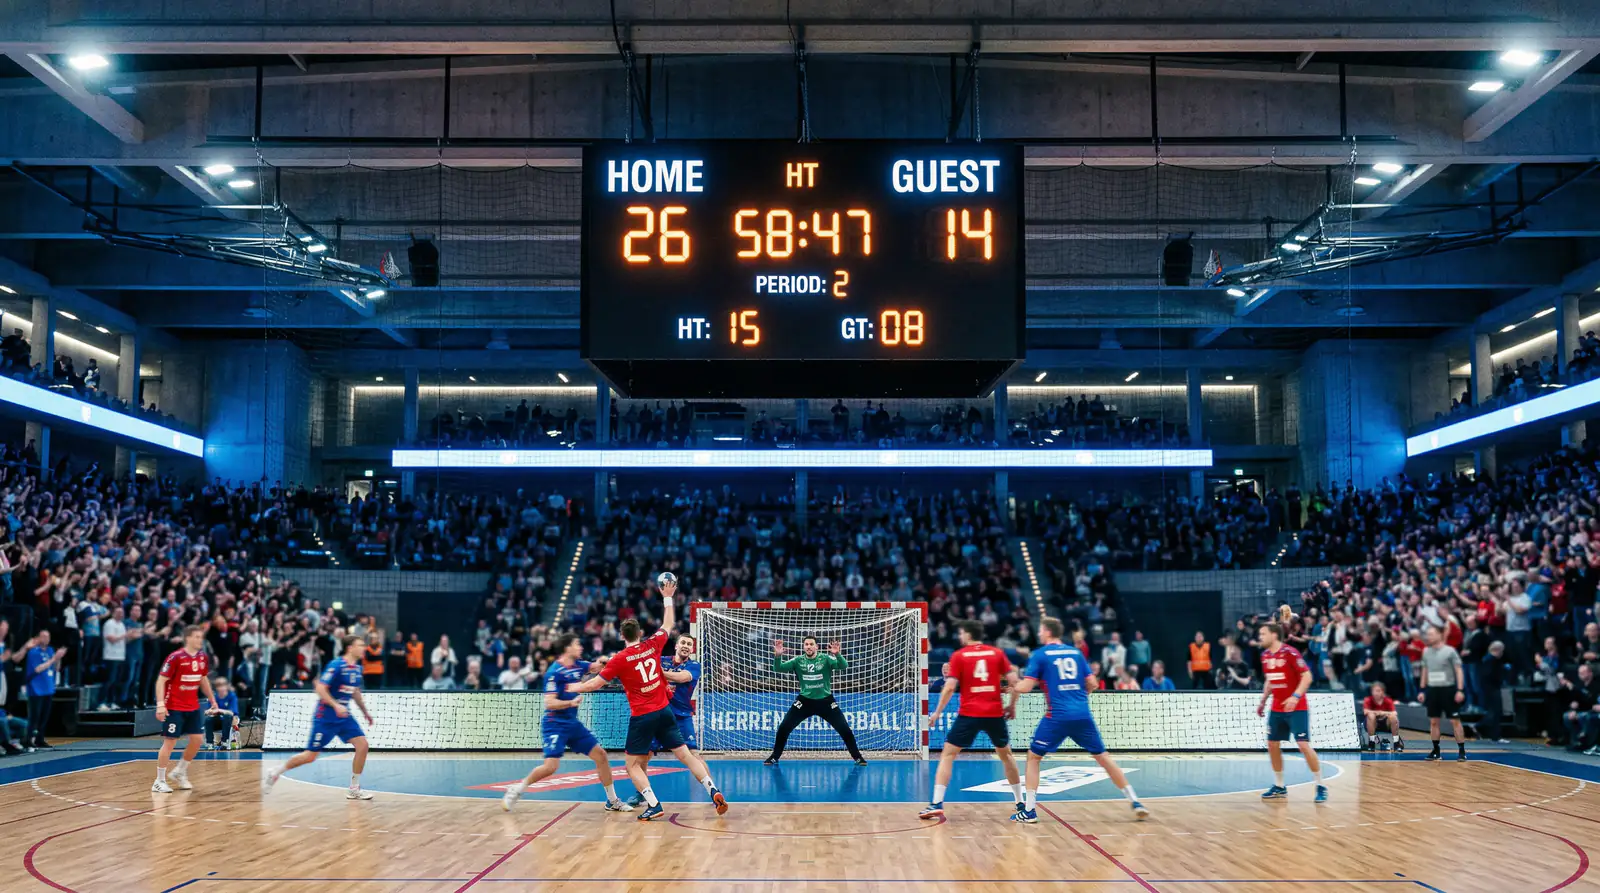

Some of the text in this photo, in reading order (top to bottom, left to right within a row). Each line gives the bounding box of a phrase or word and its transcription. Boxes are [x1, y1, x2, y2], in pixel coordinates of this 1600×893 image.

[607, 159, 703, 193] HOME
[786, 163, 819, 188] HT
[892, 159, 1000, 193] GUEST
[622, 205, 692, 264] 26
[733, 208, 872, 259] 58:47
[946, 208, 993, 261] 14
[756, 270, 849, 298] PERIOD: 2
[678, 310, 761, 346] HT: 15
[841, 310, 925, 346] GT: 08
[634, 657, 659, 683] 12
[807, 663, 815, 673] 12
[973, 659, 989, 681] 4
[1053, 657, 1078, 680] 19
[168, 723, 176, 733] 8
